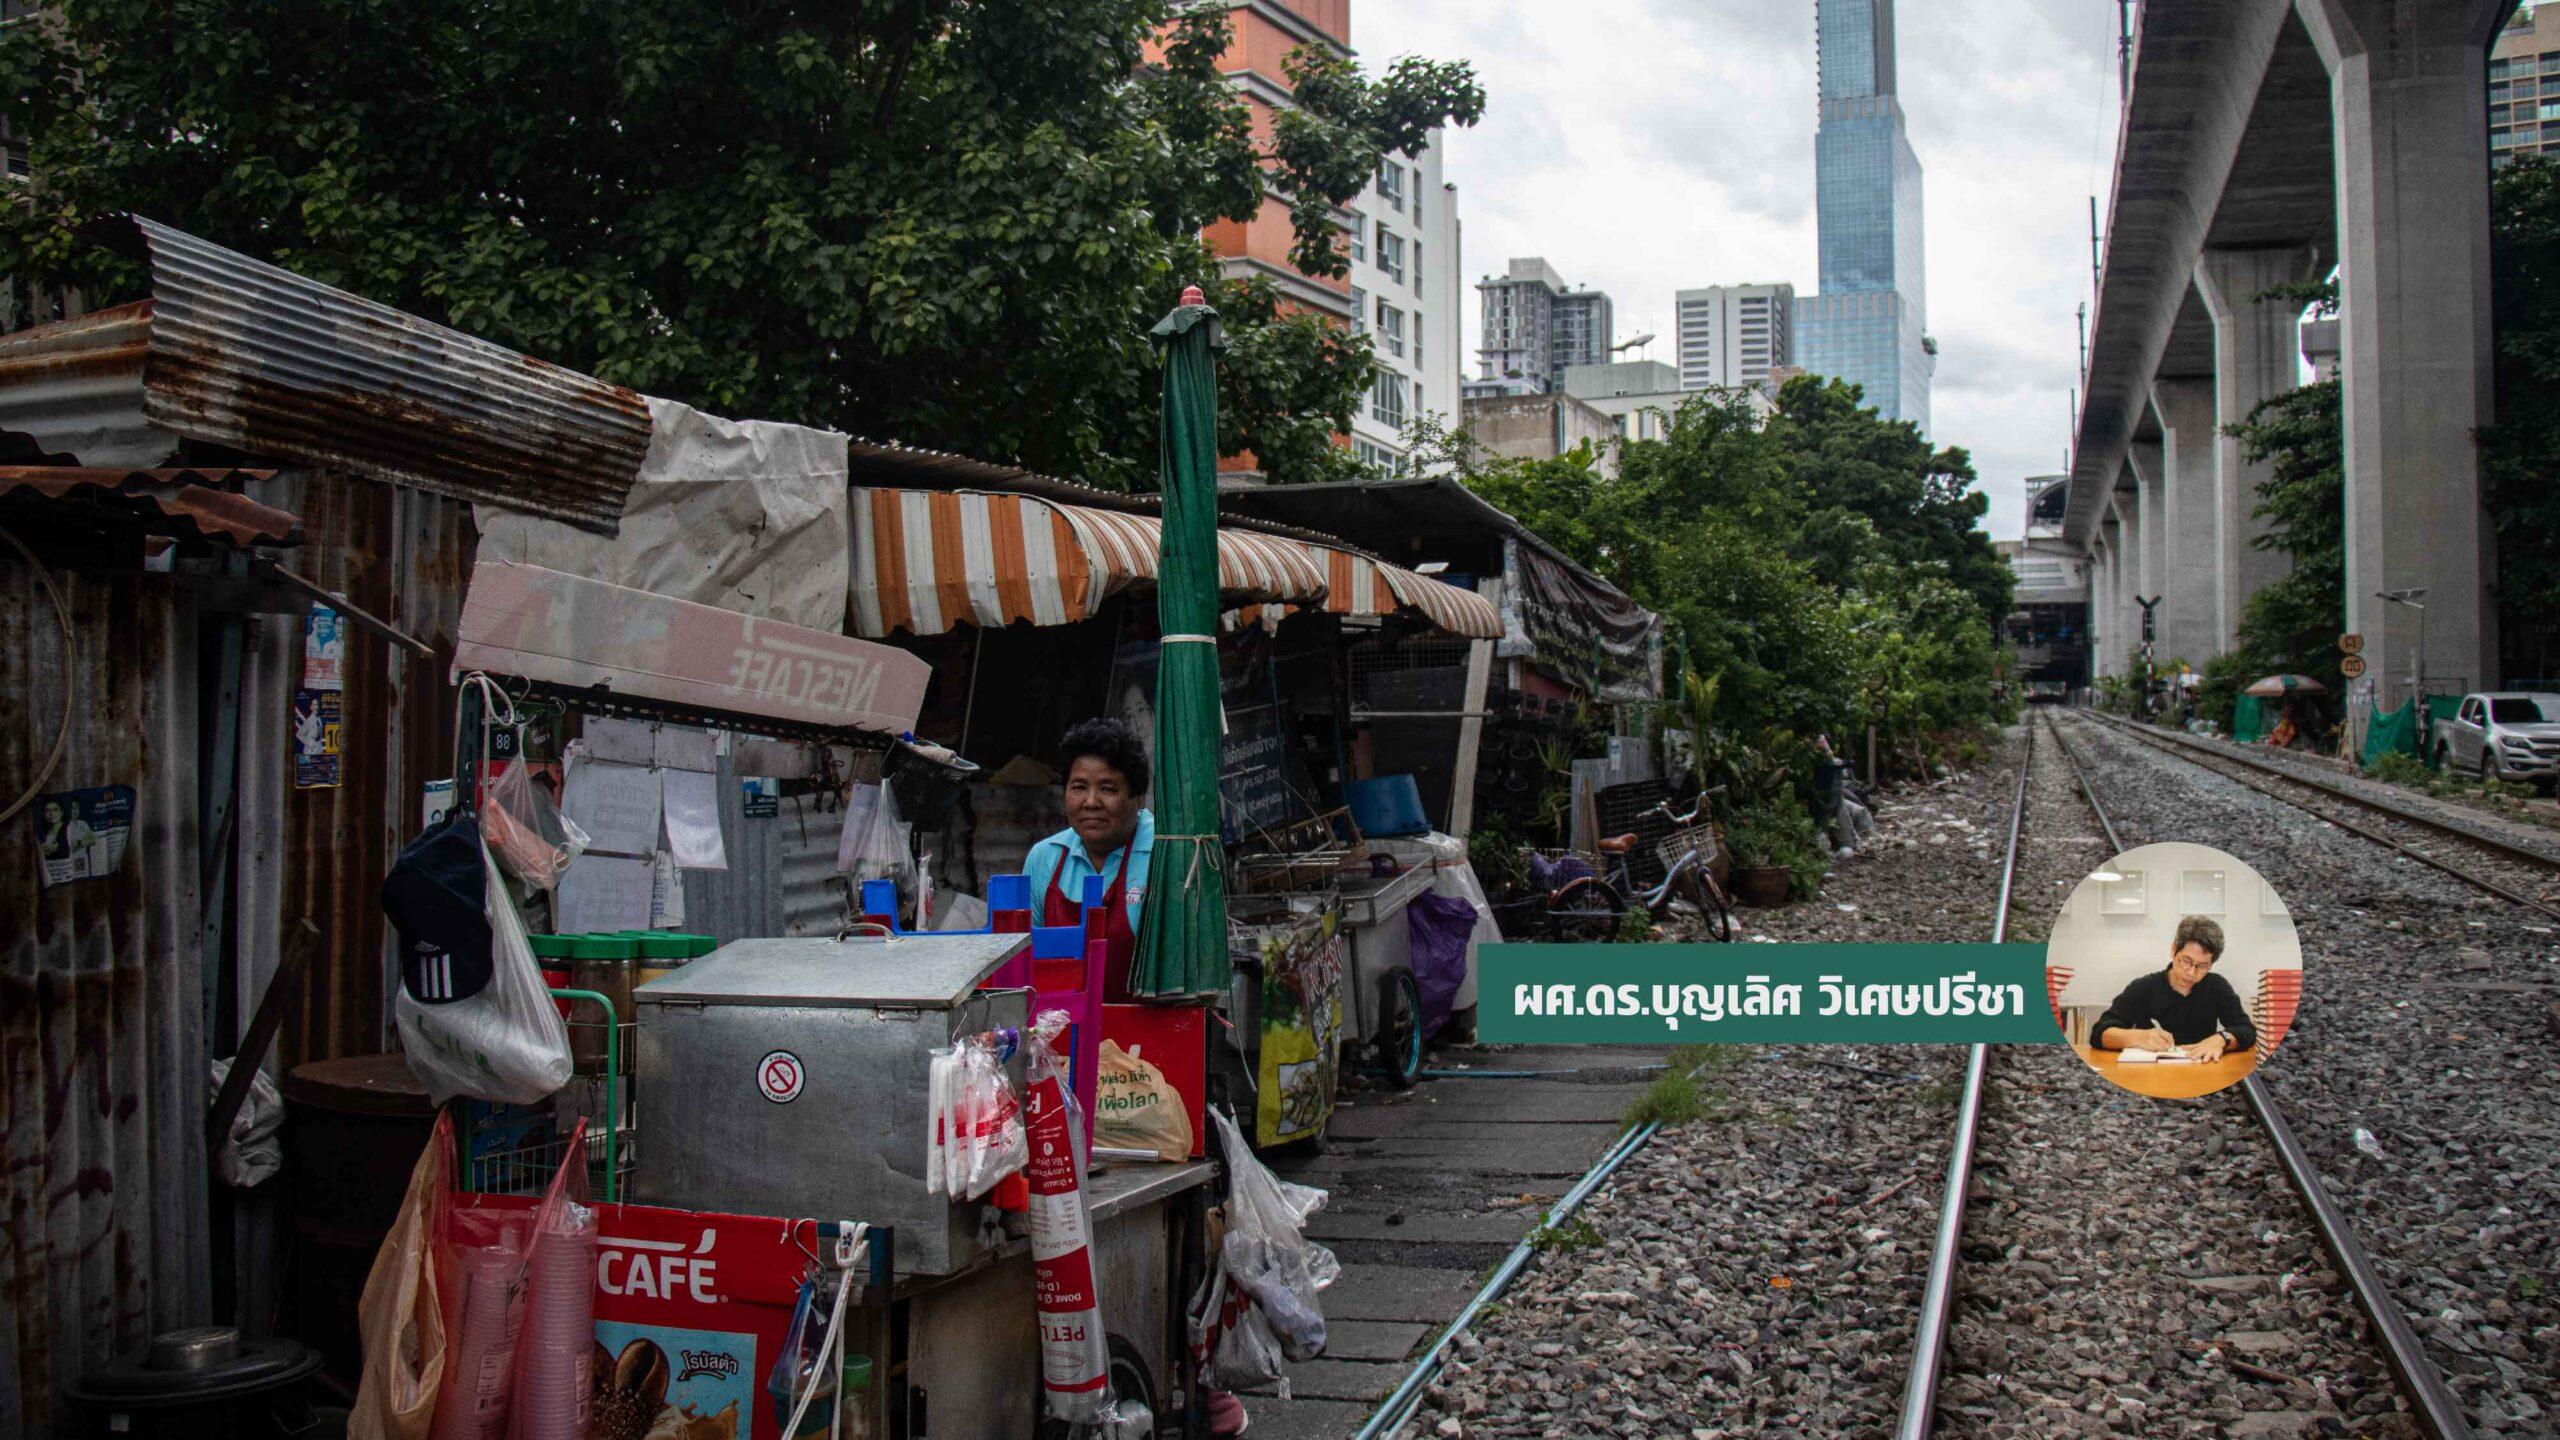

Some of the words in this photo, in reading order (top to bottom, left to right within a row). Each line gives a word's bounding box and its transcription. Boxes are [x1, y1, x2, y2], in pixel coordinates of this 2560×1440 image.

[1098, 1088, 1159, 1110] เพื่อโลก
[1051, 1325, 1086, 1342] PET
[682, 1350, 738, 1374] โรบัสต้า
